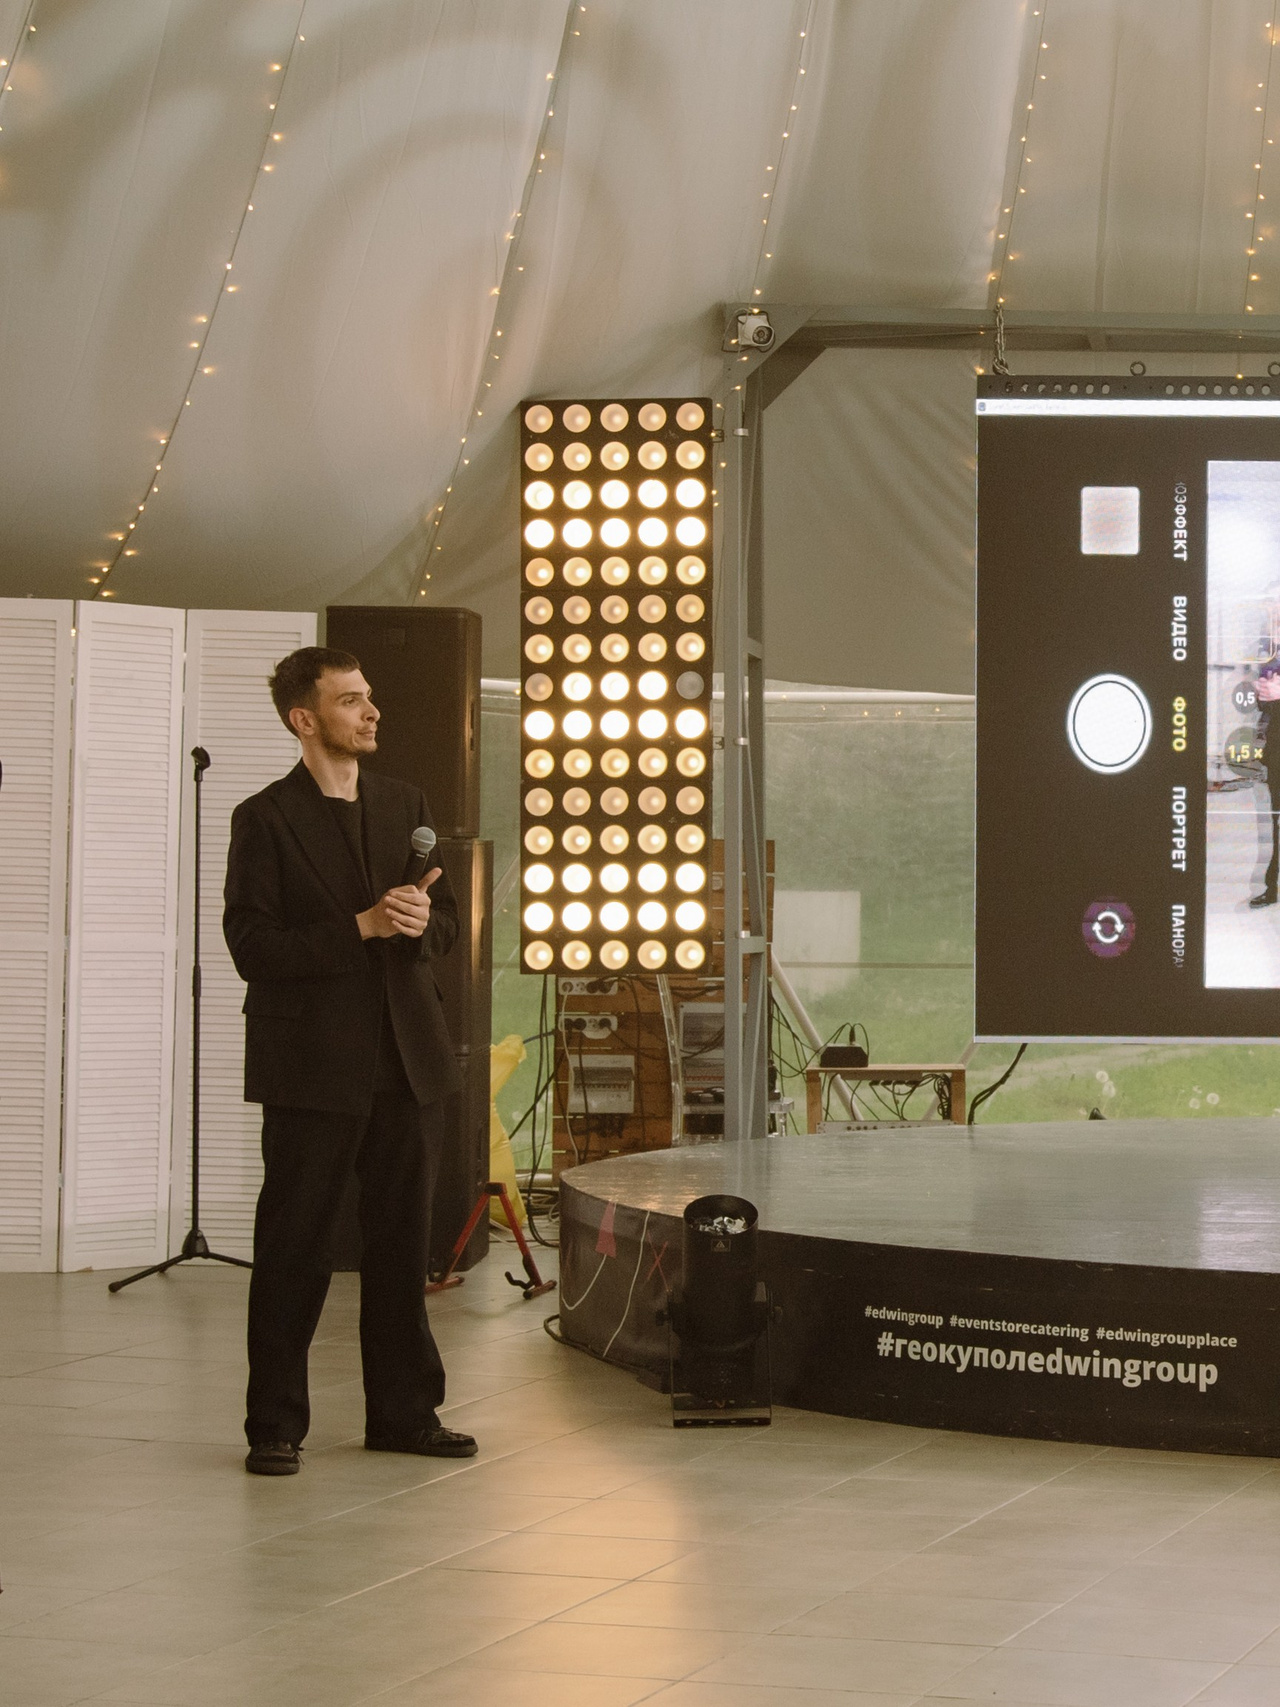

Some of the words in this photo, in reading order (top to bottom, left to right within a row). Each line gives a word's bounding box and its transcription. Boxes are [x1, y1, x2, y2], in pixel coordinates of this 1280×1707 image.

[1172, 595, 1188, 661] ВИДЕО
[1172, 696, 1187, 751] ФОТО
[1235, 691, 1256, 707] 0,5
[1228, 744, 1250, 763] 1,5
[1171, 786, 1187, 871] ПОРТРЕТ
[864, 1305, 944, 1329] #edwingroup
[949, 1315, 1089, 1342] #eventstorecatering
[1096, 1327, 1238, 1349] #edwingroupplace
[876, 1331, 1218, 1392] #геокуполedwingroup
